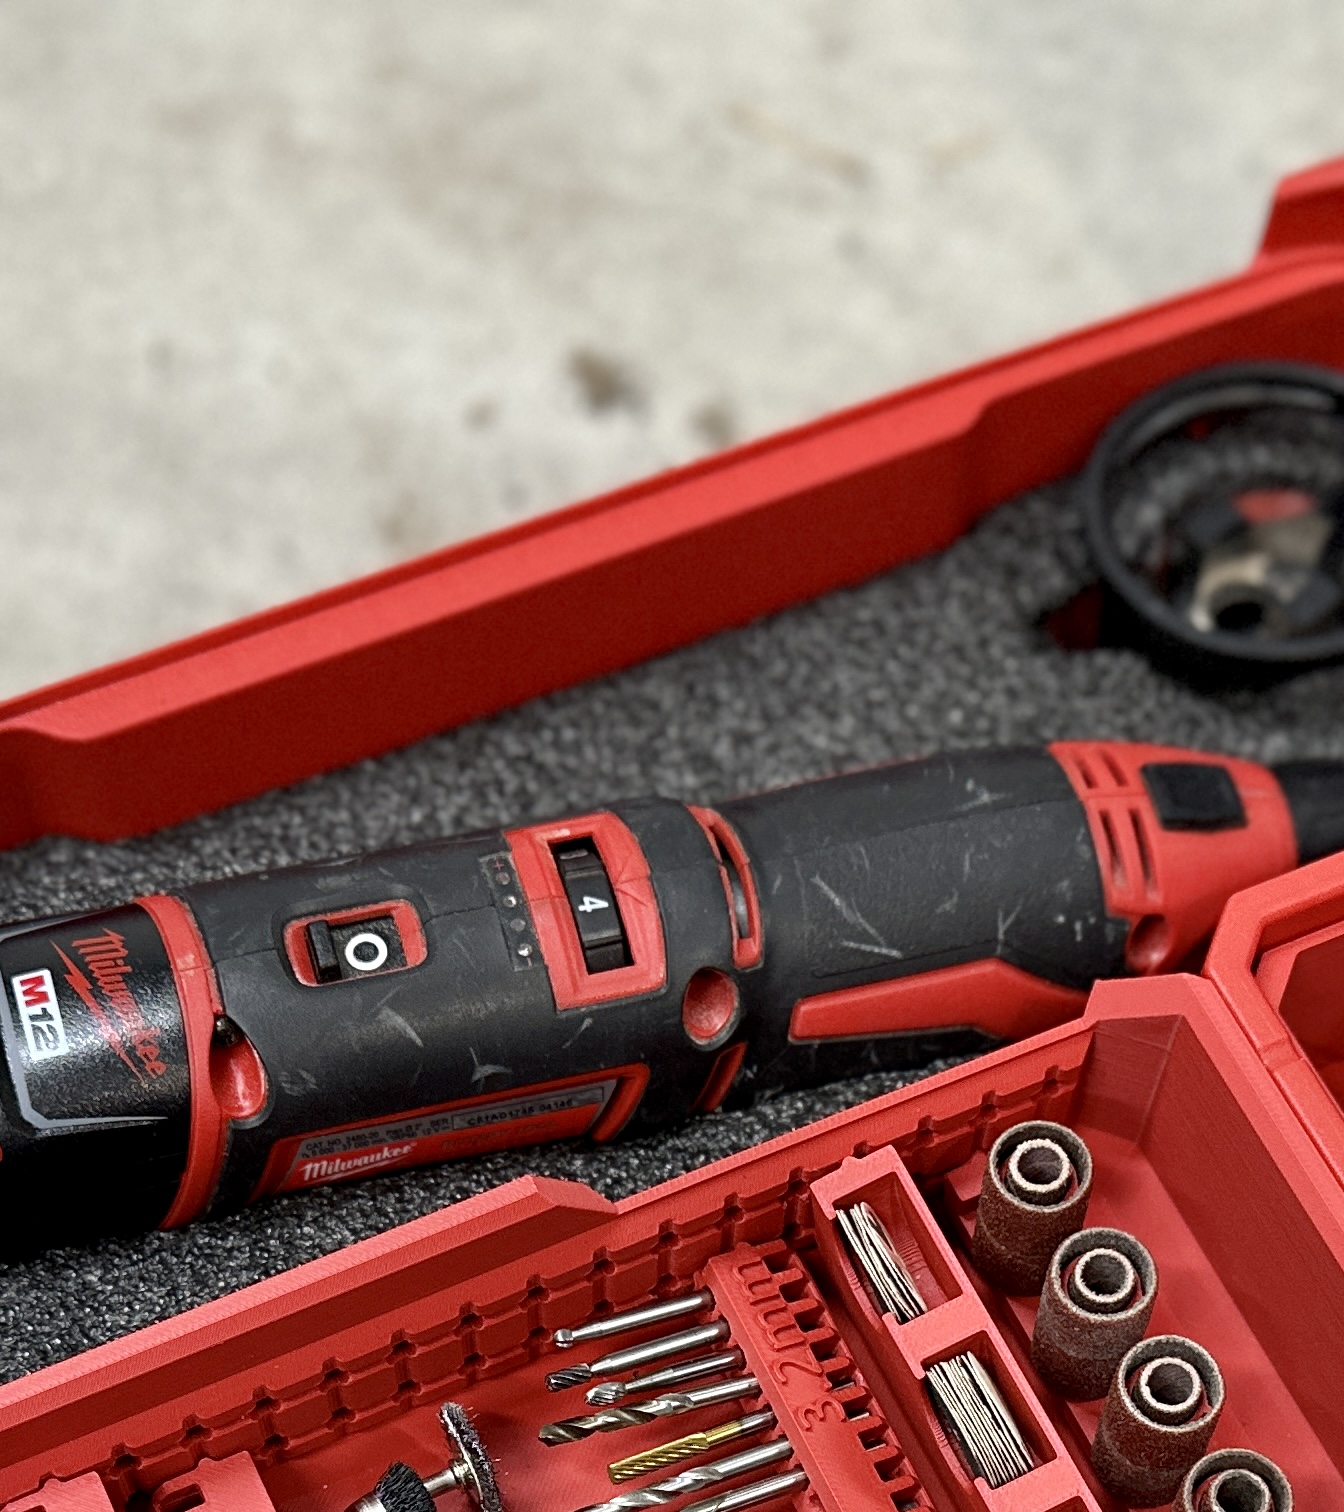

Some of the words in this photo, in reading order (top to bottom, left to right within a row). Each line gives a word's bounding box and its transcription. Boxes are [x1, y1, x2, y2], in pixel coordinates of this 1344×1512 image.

[578, 896, 609, 913] 4
[19, 974, 61, 1052] M12
[299, 1145, 413, 1181] Milwaukee
